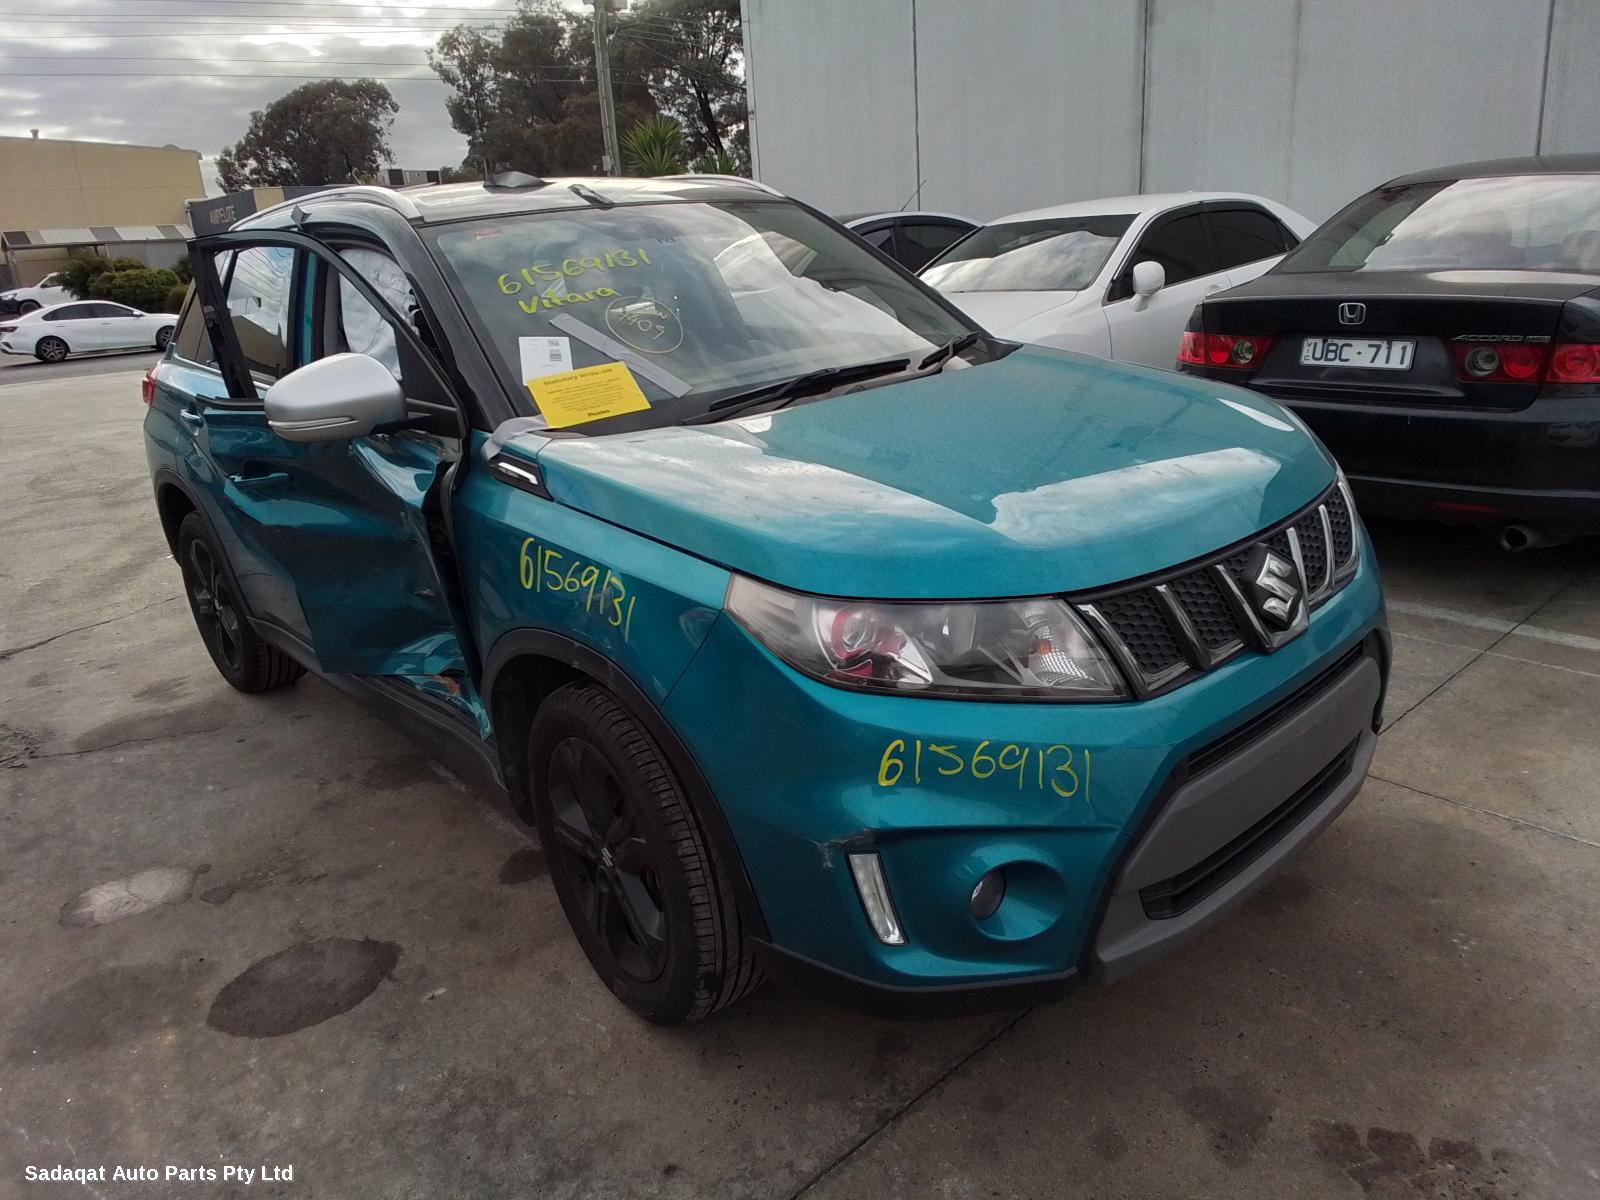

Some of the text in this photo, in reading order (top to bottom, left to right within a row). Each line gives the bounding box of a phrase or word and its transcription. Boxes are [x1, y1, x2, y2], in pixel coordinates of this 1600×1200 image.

[498, 248, 651, 294] 61569131
[518, 287, 619, 314] Vitara
[1303, 341, 1312, 361] VIC
[1451, 334, 1524, 342] ACCORD
[1311, 341, 1407, 365] UBC 711
[519, 537, 636, 643] 61569131
[877, 739, 1092, 803] 61569131
